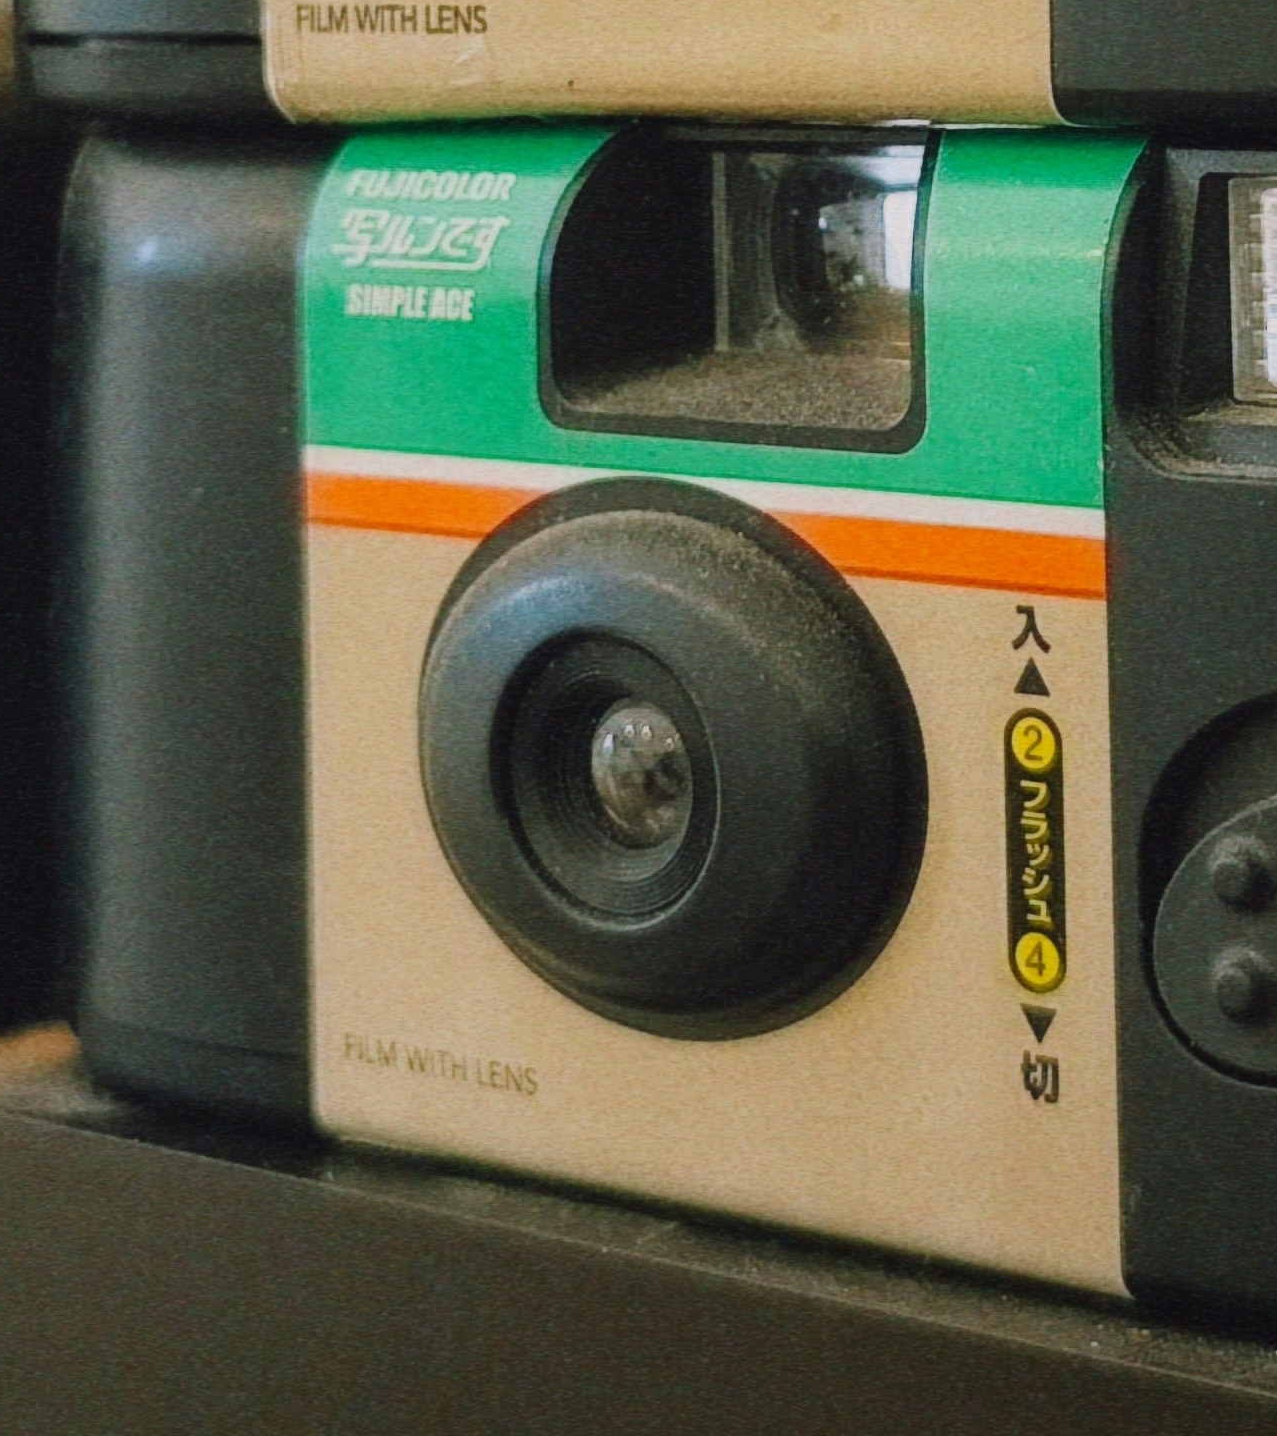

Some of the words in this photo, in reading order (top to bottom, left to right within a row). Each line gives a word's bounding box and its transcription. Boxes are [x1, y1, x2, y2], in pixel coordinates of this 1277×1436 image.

[295, 4, 349, 33] FILM
[354, 4, 418, 33] WITH
[424, 4, 488, 35] LENS
[347, 169, 516, 201] FUJICOLOR
[348, 283, 426, 318] SIMPLE
[428, 287, 475, 322] ACE
[1010, 604, 1052, 654] 入
[1019, 779, 1053, 924] フラッシュ
[344, 1032, 399, 1067] FILM
[405, 1045, 469, 1082] WITH
[475, 1057, 540, 1097] LENS
[1019, 1049, 1061, 1105] 切
